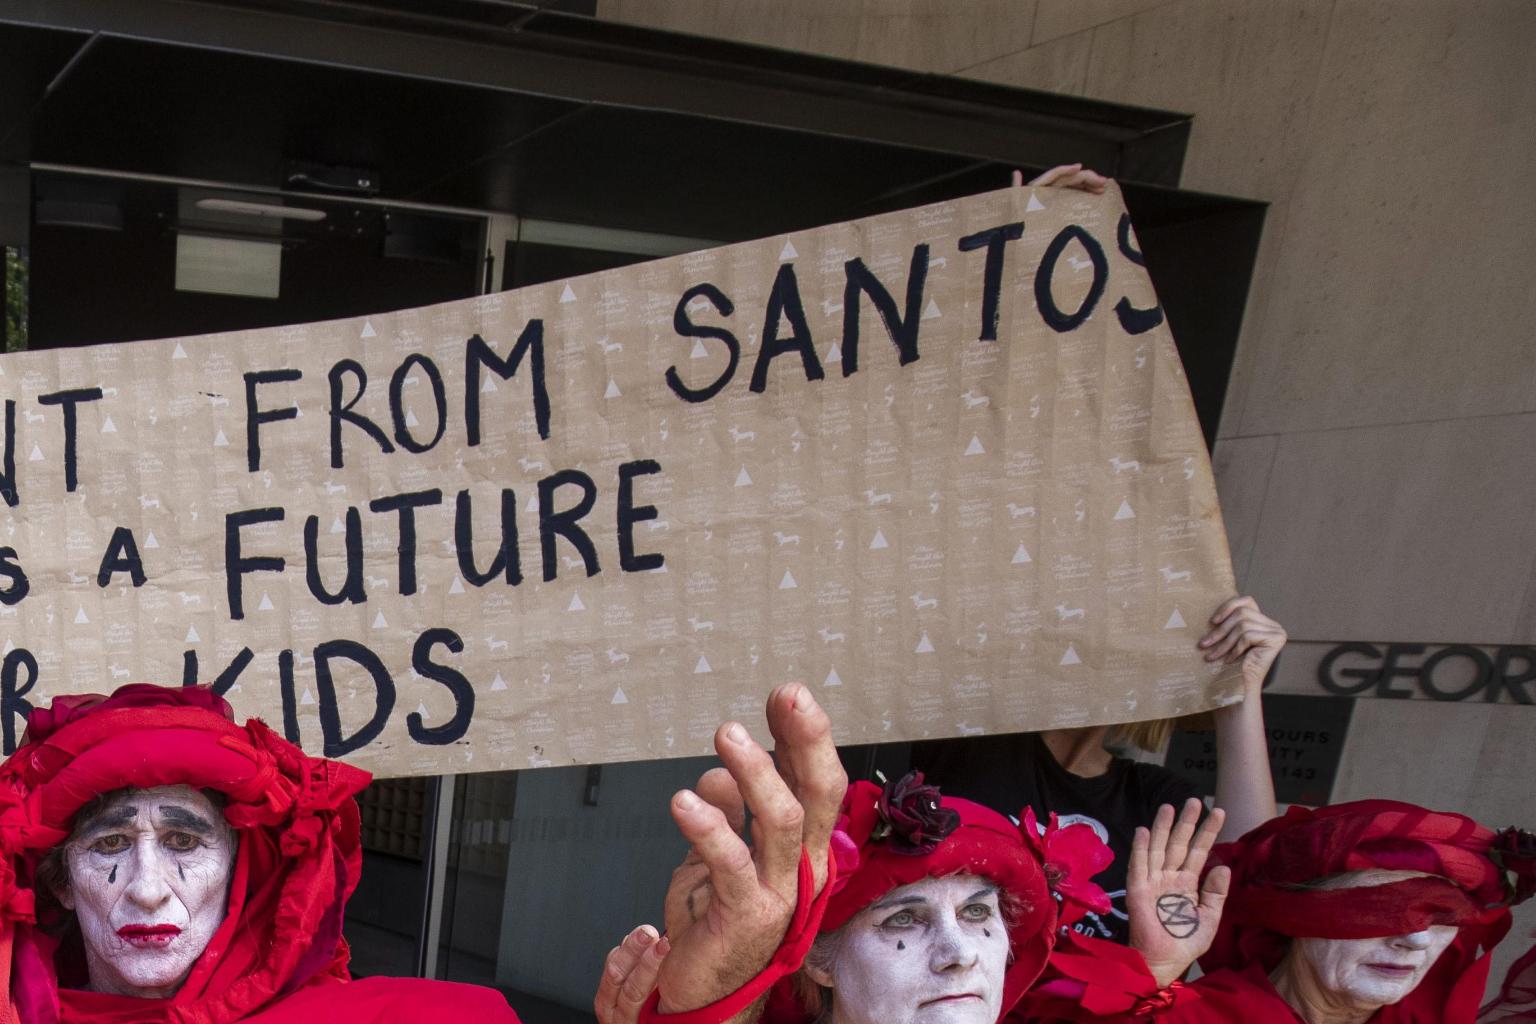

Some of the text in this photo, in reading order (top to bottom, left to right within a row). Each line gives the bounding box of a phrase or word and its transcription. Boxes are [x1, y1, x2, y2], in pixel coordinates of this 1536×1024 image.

[243, 317, 551, 473] FROM
[664, 212, 1164, 404] SANTOS
[96, 526, 148, 588] A
[224, 459, 666, 621] FUTURE
[1318, 643, 1536, 705] GEOR
[1265, 728, 1331, 745] OURS
